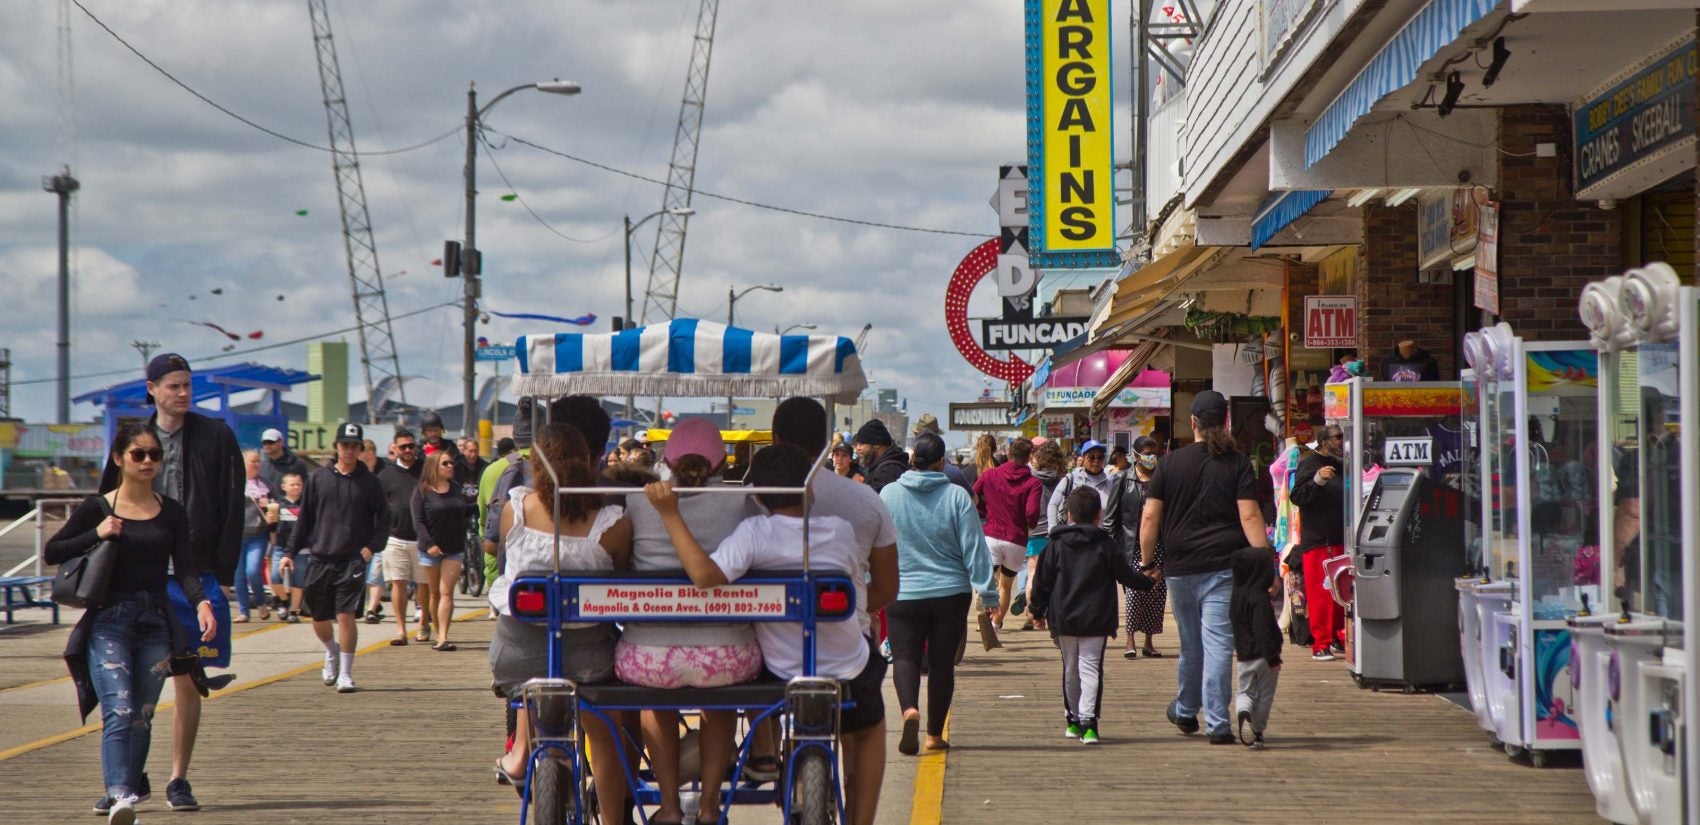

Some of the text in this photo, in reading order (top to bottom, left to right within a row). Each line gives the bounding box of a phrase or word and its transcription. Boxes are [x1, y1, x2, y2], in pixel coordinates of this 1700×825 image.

[1666, 55, 1684, 88] FUN
[1580, 93, 1682, 179] CRANES SKEEBALL
[989, 322, 1089, 345] FUNCAD
[1308, 308, 1354, 337] ATM
[1389, 442, 1428, 461] ATM
[607, 588, 758, 600] Magnolia Bike Rental
[583, 602, 782, 614] Magnolia & Ocean Aves. (609) 802-7690
